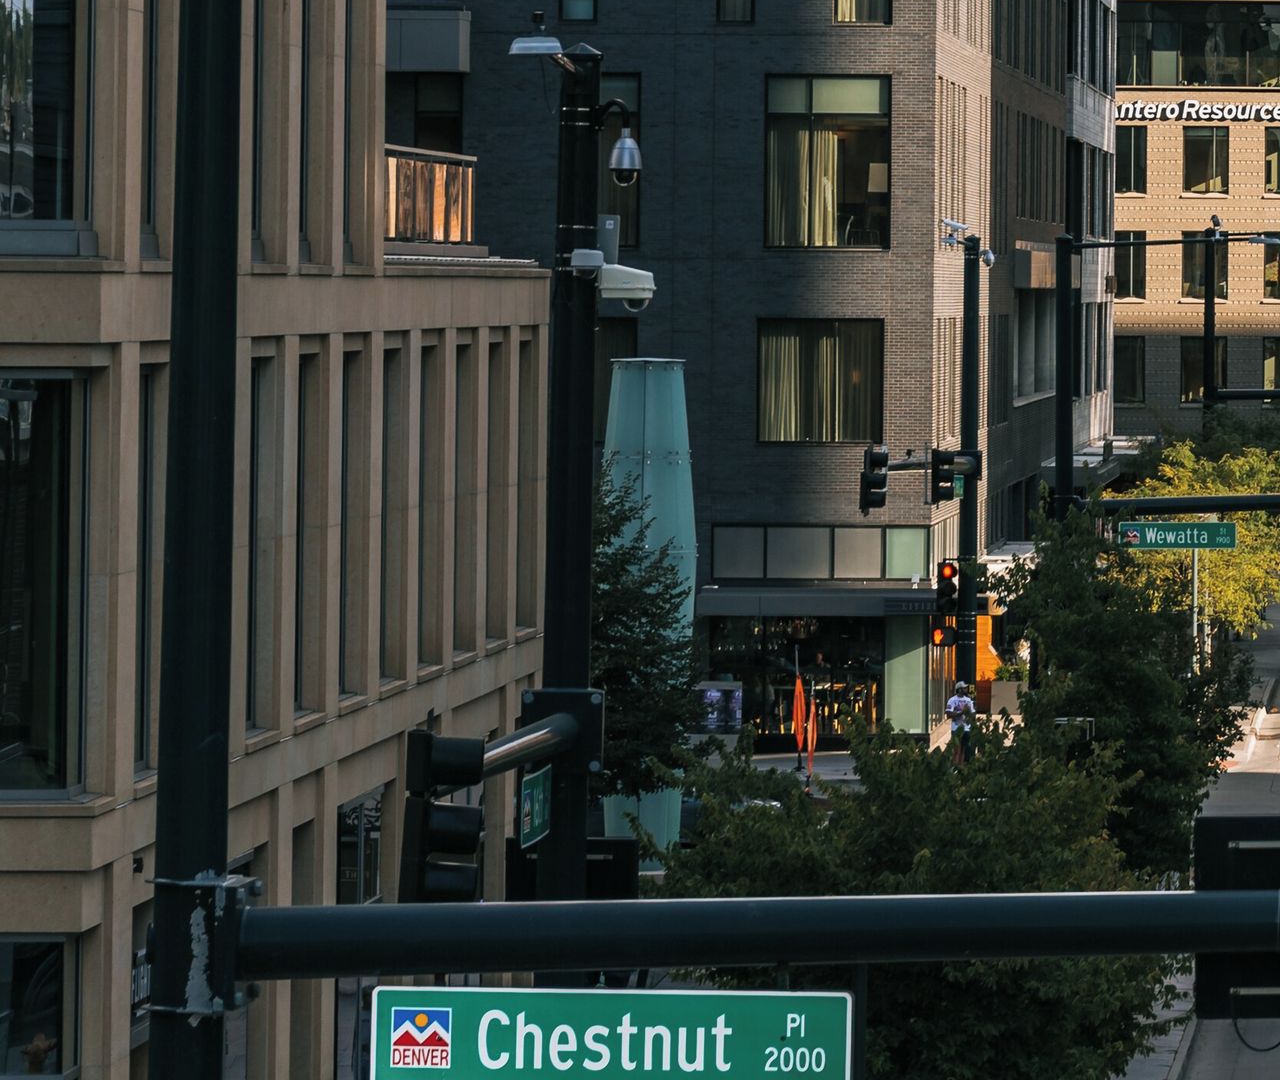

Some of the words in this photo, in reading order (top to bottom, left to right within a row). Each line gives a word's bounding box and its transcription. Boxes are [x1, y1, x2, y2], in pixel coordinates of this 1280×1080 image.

[1115, 99, 1180, 119] ntero
[1145, 527, 1208, 544] Wewatta
[1215, 536, 1231, 544] 1900
[786, 1013, 805, 1038] Pl
[477, 1009, 733, 1072] Chestnut
[392, 1048, 449, 1066] DENVER
[764, 1047, 826, 1072] 2000
